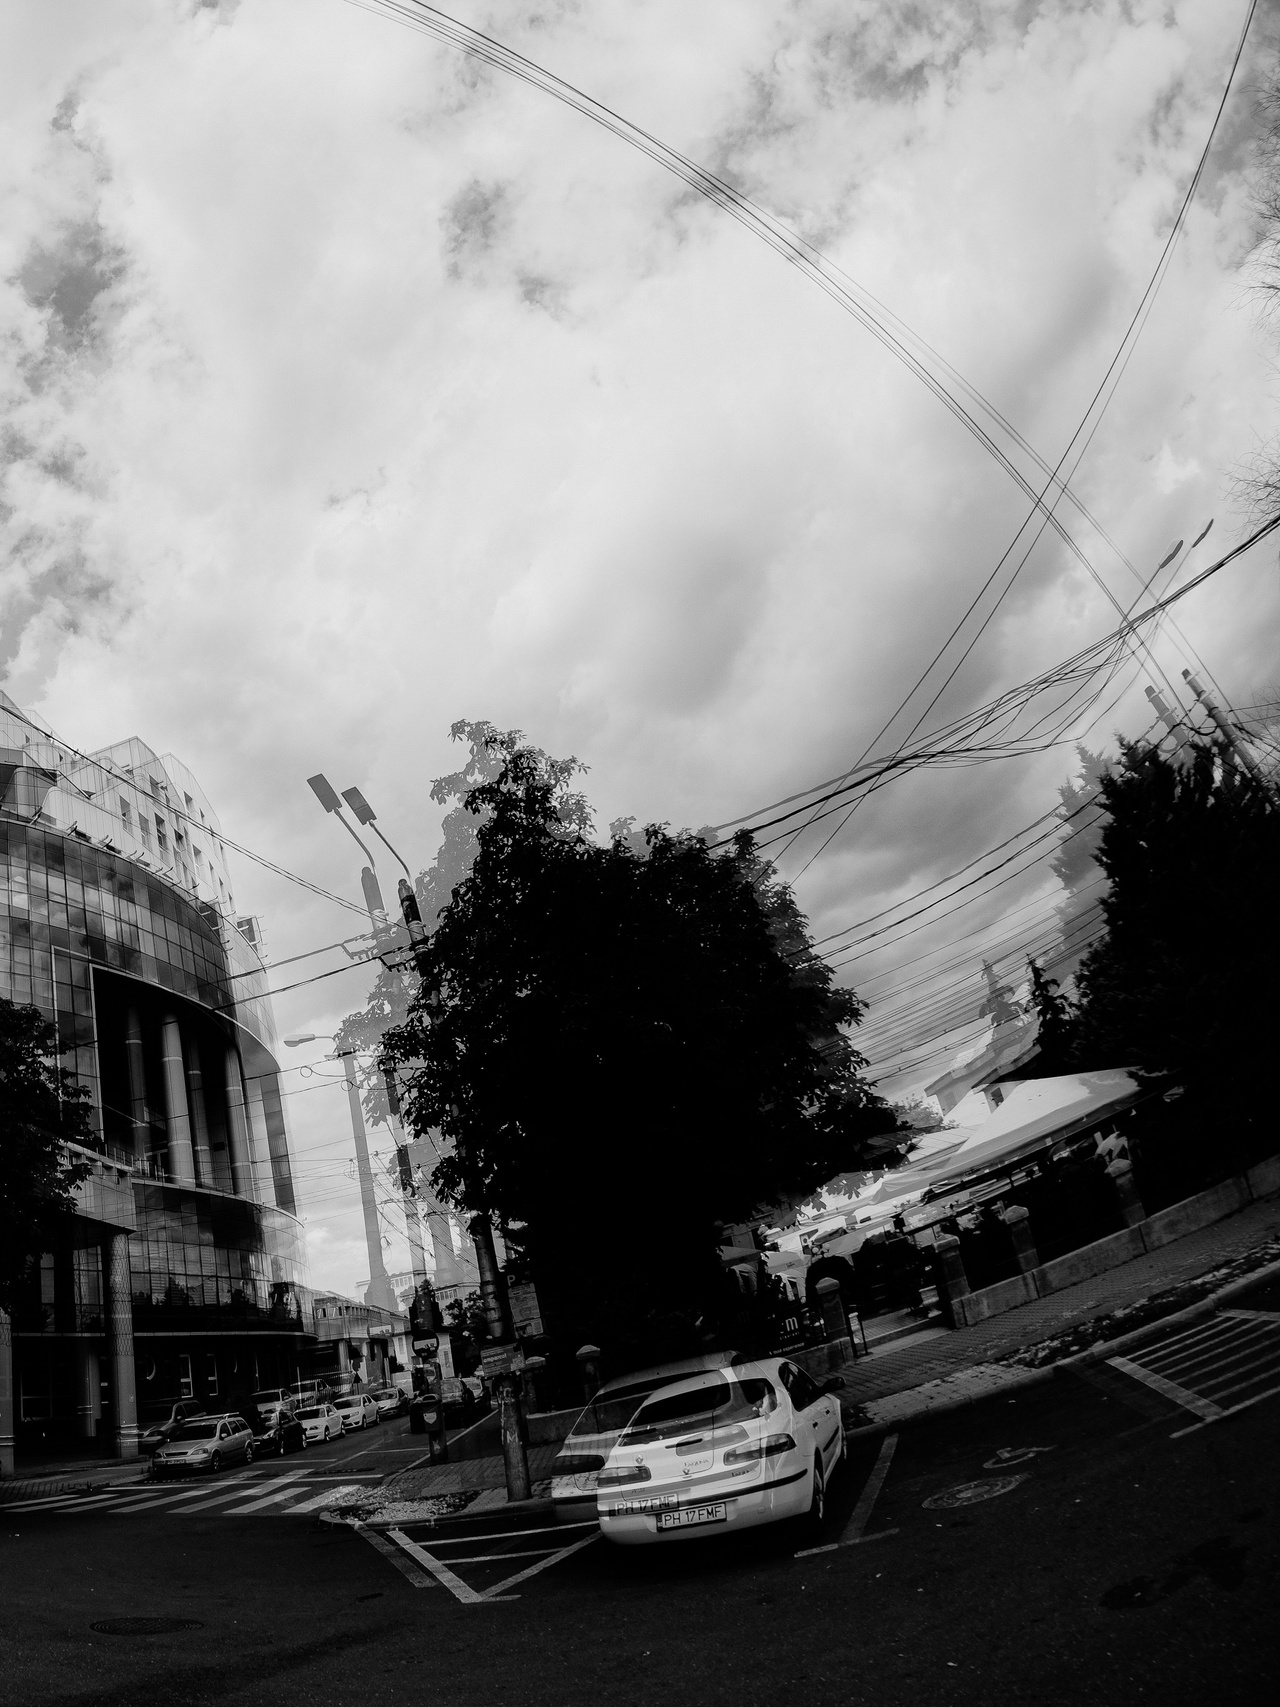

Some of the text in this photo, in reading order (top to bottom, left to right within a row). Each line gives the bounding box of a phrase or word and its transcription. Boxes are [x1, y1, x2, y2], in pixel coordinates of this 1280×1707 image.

[506, 1274, 517, 1287] P
[664, 1505, 723, 1527] PH 17 FMF
